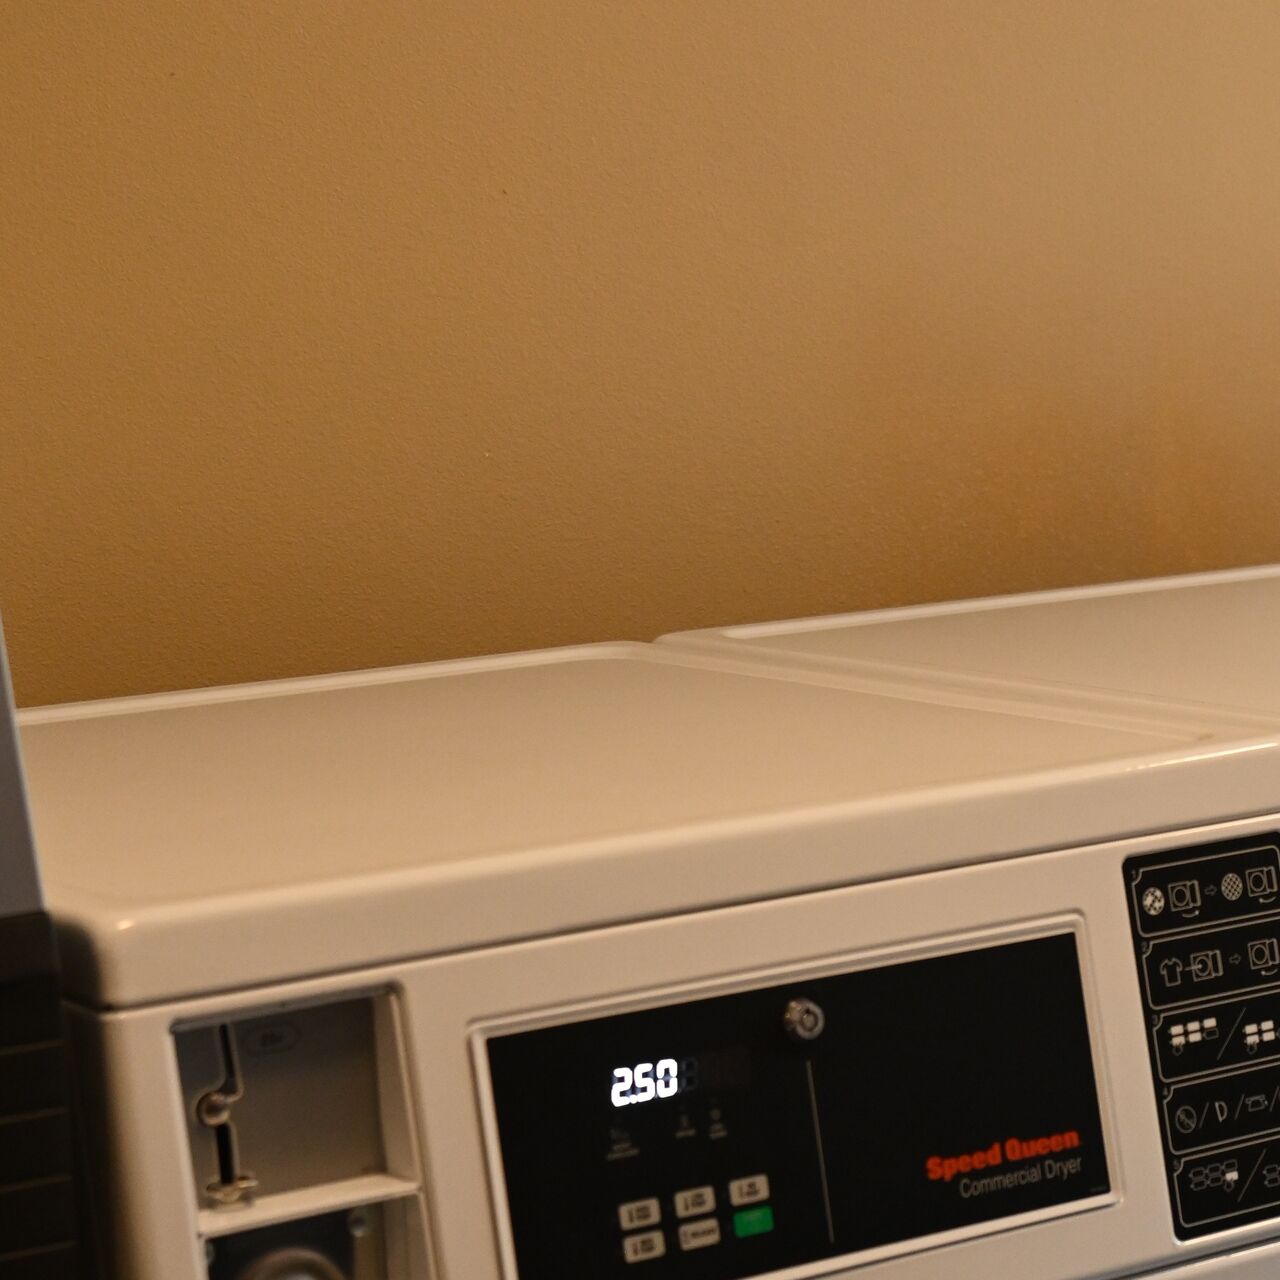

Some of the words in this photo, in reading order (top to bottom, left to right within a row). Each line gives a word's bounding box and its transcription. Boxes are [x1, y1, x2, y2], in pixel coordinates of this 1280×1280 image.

[611, 1058, 678, 1107] 2.50
[926, 1140, 1003, 1182] Speed
[1004, 1130, 1080, 1162] Queen
[959, 1164, 1043, 1199] Commercial
[1045, 1157, 1082, 1181] Dryer
